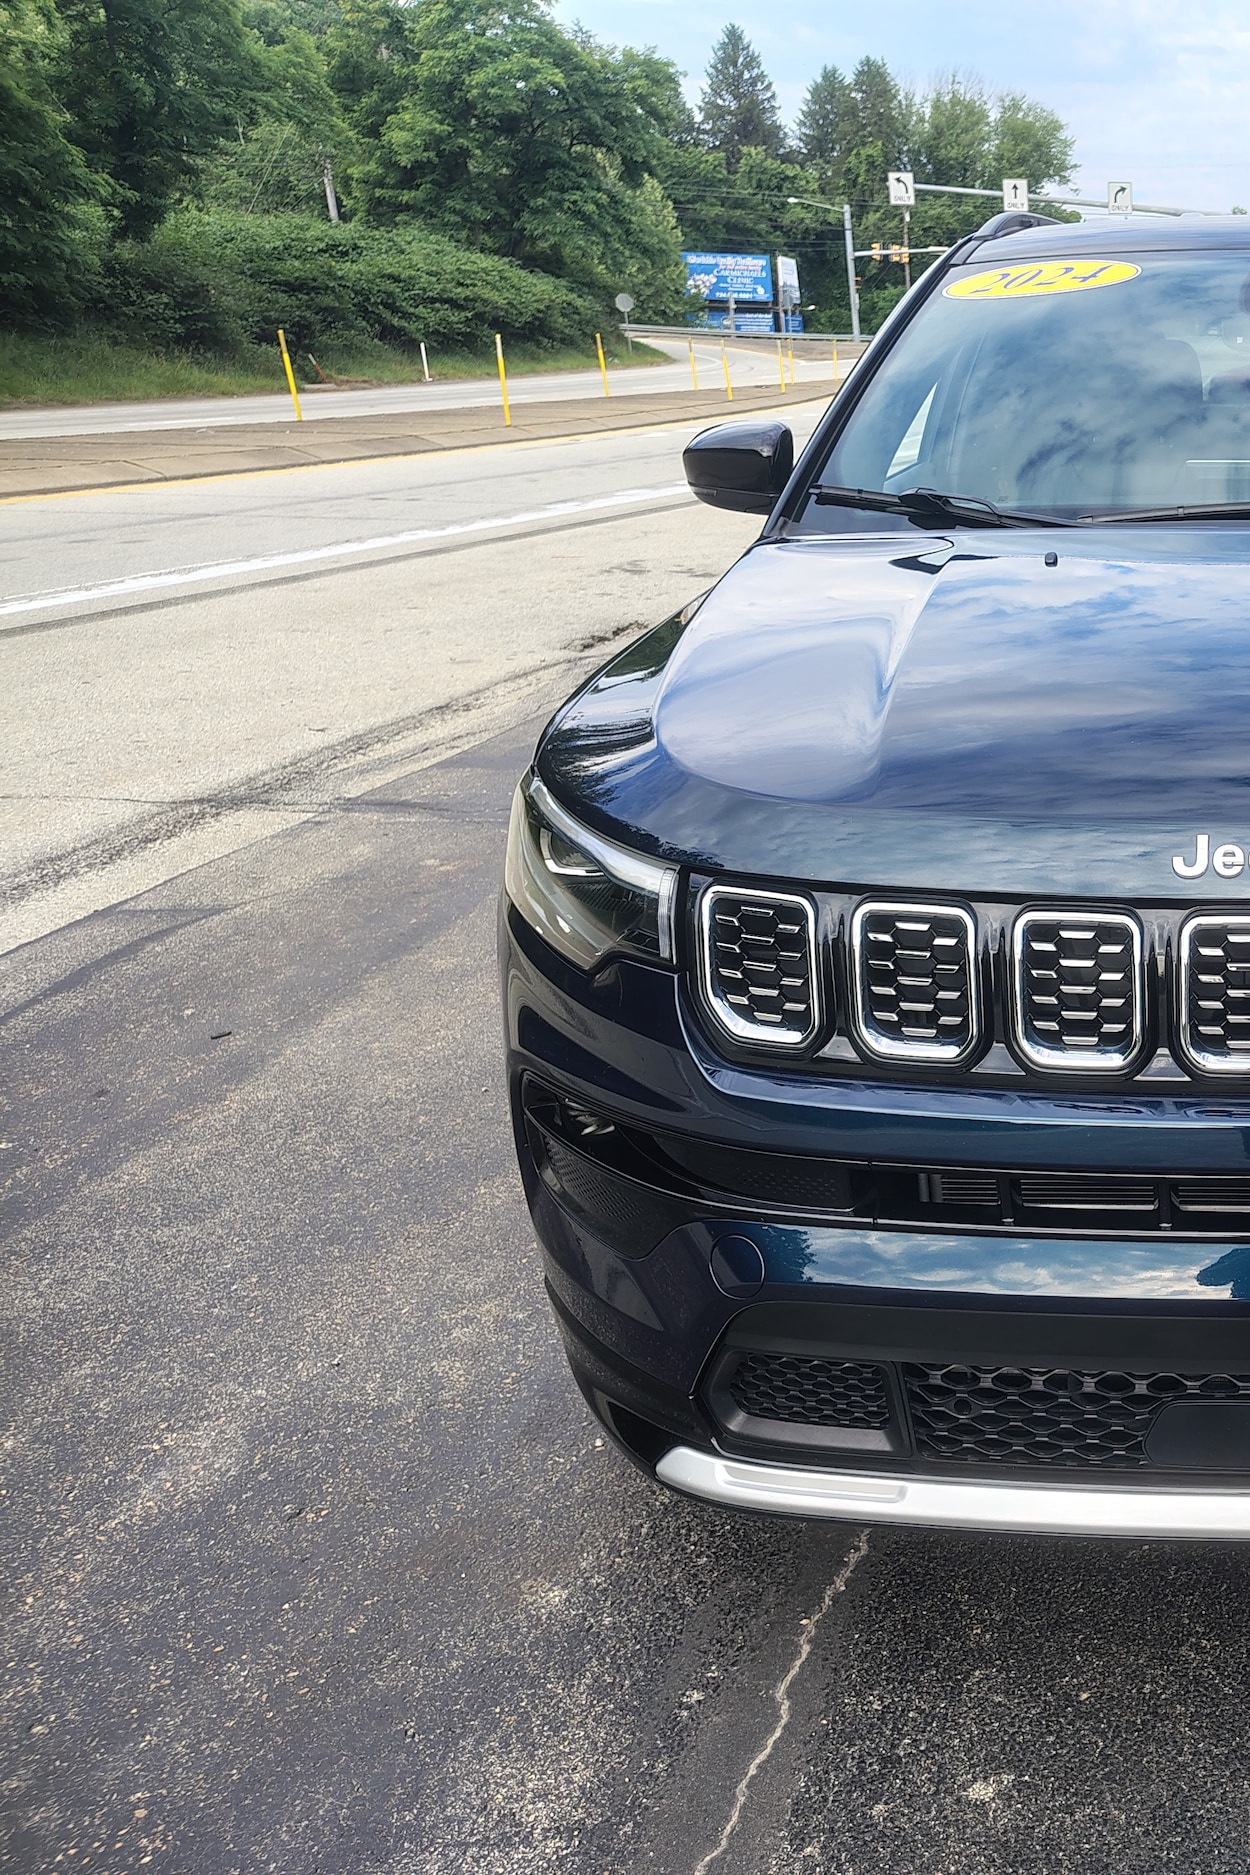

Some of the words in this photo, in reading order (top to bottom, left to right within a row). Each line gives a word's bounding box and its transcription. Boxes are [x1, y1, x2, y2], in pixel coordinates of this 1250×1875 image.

[893, 194, 912, 203] ONLY
[1006, 202, 1025, 210] ONLY
[1111, 204, 1130, 212] ONLY
[969, 264, 1114, 295] 2024
